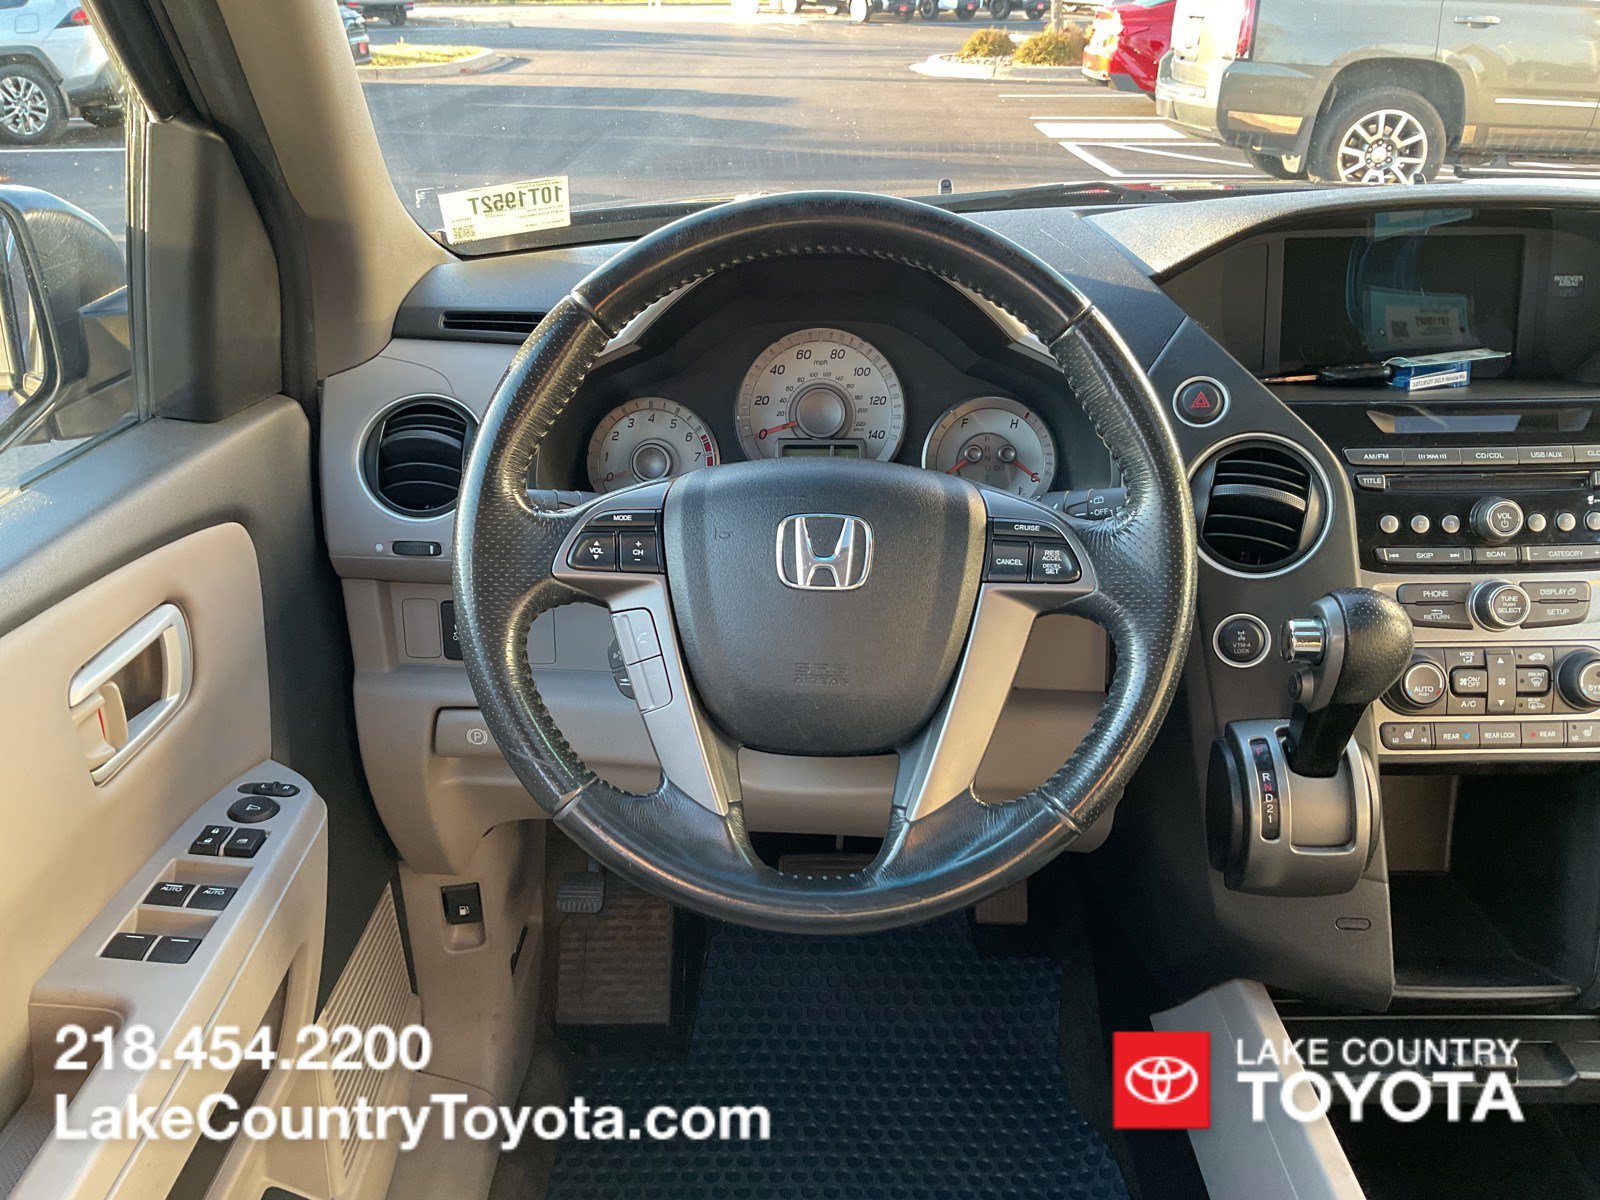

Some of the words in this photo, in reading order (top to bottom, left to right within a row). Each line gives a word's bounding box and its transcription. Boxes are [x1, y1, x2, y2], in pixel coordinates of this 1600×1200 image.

[796, 349, 811, 360] 60
[830, 349, 846, 360] 80
[770, 364, 785, 375] 40
[853, 367, 871, 376] 100
[754, 395, 770, 406] 20
[869, 396, 887, 406] 120
[627, 418, 635, 428] 3
[647, 413, 655, 423] 4
[961, 418, 968, 428] F
[669, 418, 678, 429] 5
[1009, 418, 1019, 429] H
[611, 431, 620, 441] 2
[685, 432, 693, 442] 6
[758, 428, 768, 440] 0
[867, 429, 886, 440] 140
[604, 452, 609, 462] 1
[694, 452, 702, 462] 7
[1362, 477, 1382, 485] TITLE
[1093, 507, 1109, 516] OFF
[1014, 523, 1040, 532] CRUISE
[589, 546, 604, 555] VOL
[632, 548, 644, 557] CH
[995, 558, 1023, 566] CANCEL
[1422, 590, 1449, 598] PHONE
[1540, 588, 1567, 596] DISPLAY
[1547, 608, 1570, 616] SETUP
[1460, 700, 1477, 708] A/C
[1261, 772, 1271, 782] R
[1263, 783, 1272, 792] N
[1265, 793, 1274, 803] D
[1266, 804, 1274, 814] 2
[1268, 815, 1272, 824] 1
